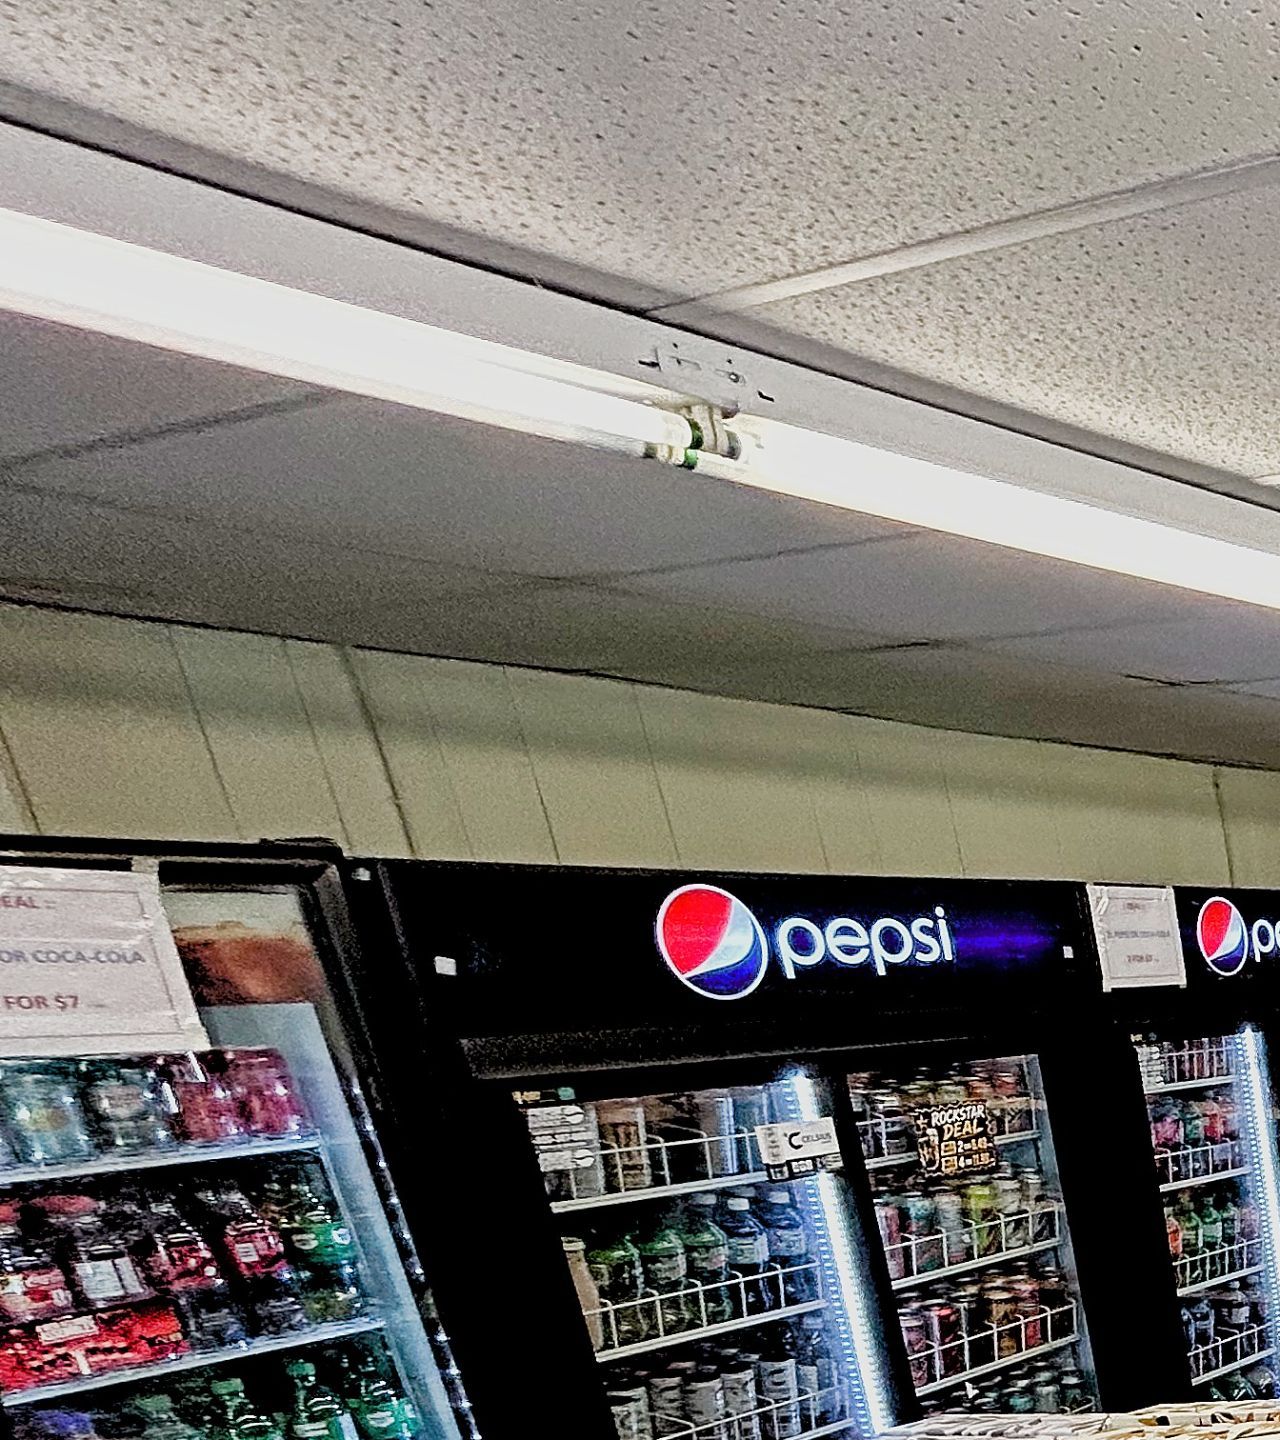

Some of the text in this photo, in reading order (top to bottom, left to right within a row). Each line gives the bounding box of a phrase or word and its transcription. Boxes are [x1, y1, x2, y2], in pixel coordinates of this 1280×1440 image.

[0, 896, 40, 910] EAL
[776, 905, 954, 980] pepsi
[32, 950, 147, 965] COCA-COLA
[4, 994, 79, 1012] FOR $7
[930, 1104, 987, 1127] ROCKSTAR
[942, 1120, 984, 1139] DEAL
